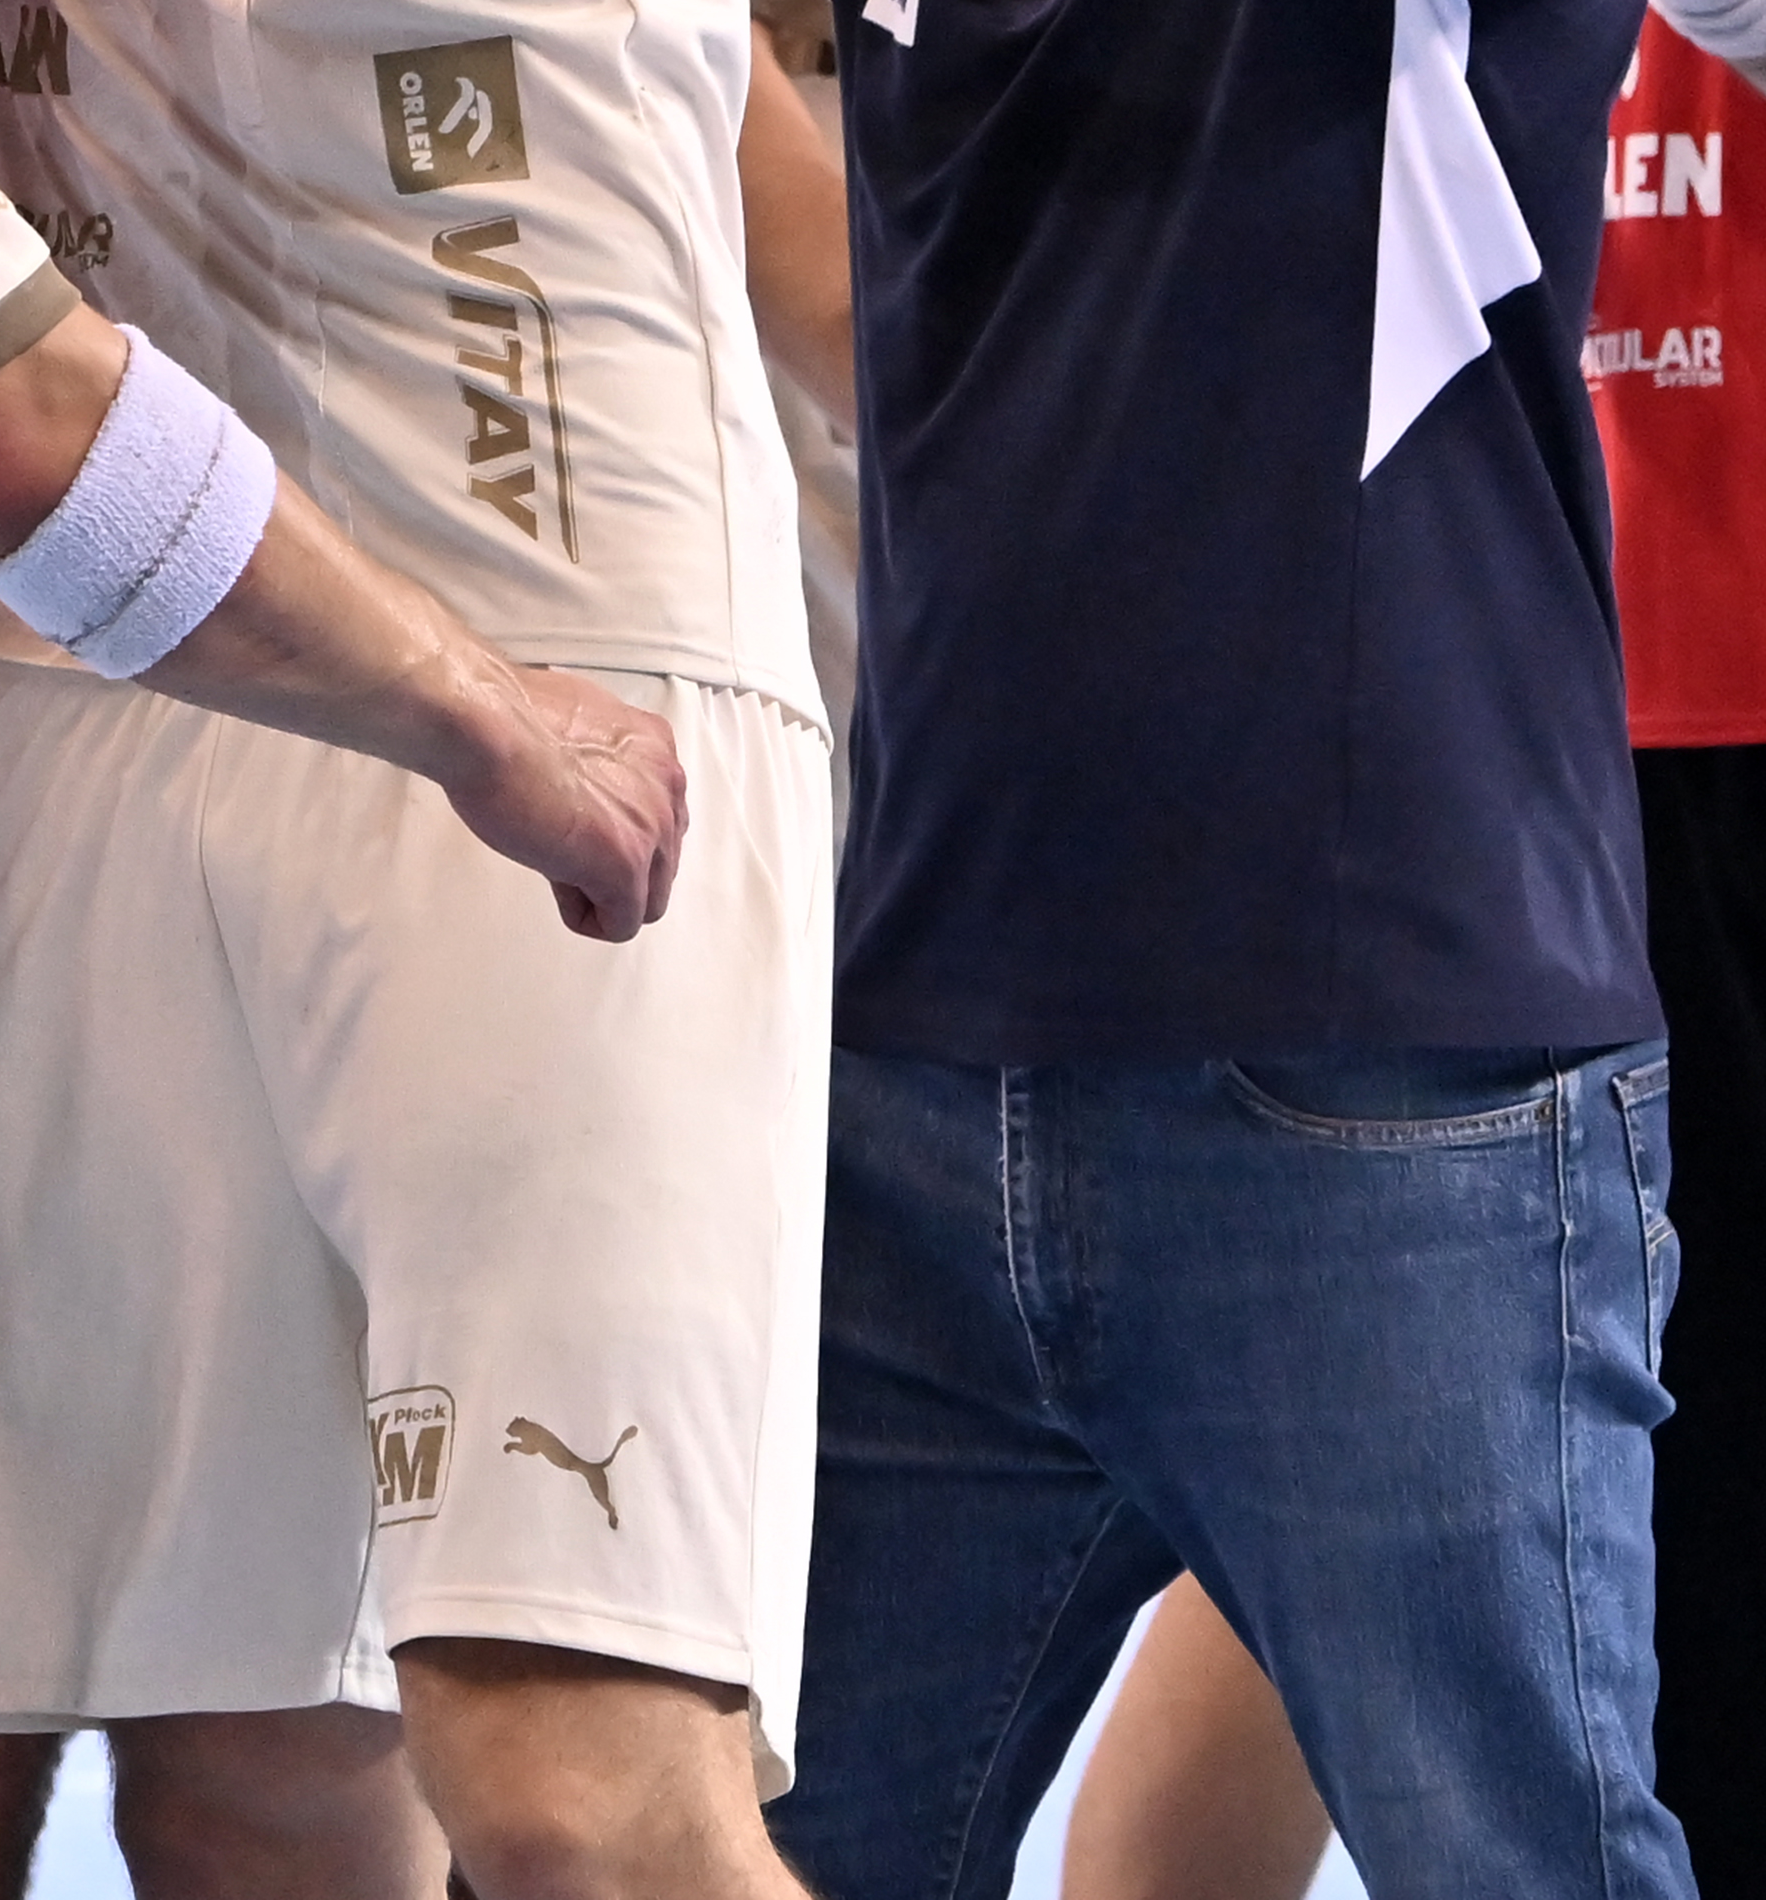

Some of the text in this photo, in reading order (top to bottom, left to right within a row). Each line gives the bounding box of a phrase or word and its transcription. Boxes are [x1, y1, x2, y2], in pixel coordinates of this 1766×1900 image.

[398, 70, 435, 175] ORLEN
[431, 215, 568, 555] VITAY
[393, 1403, 446, 1426] Płock
